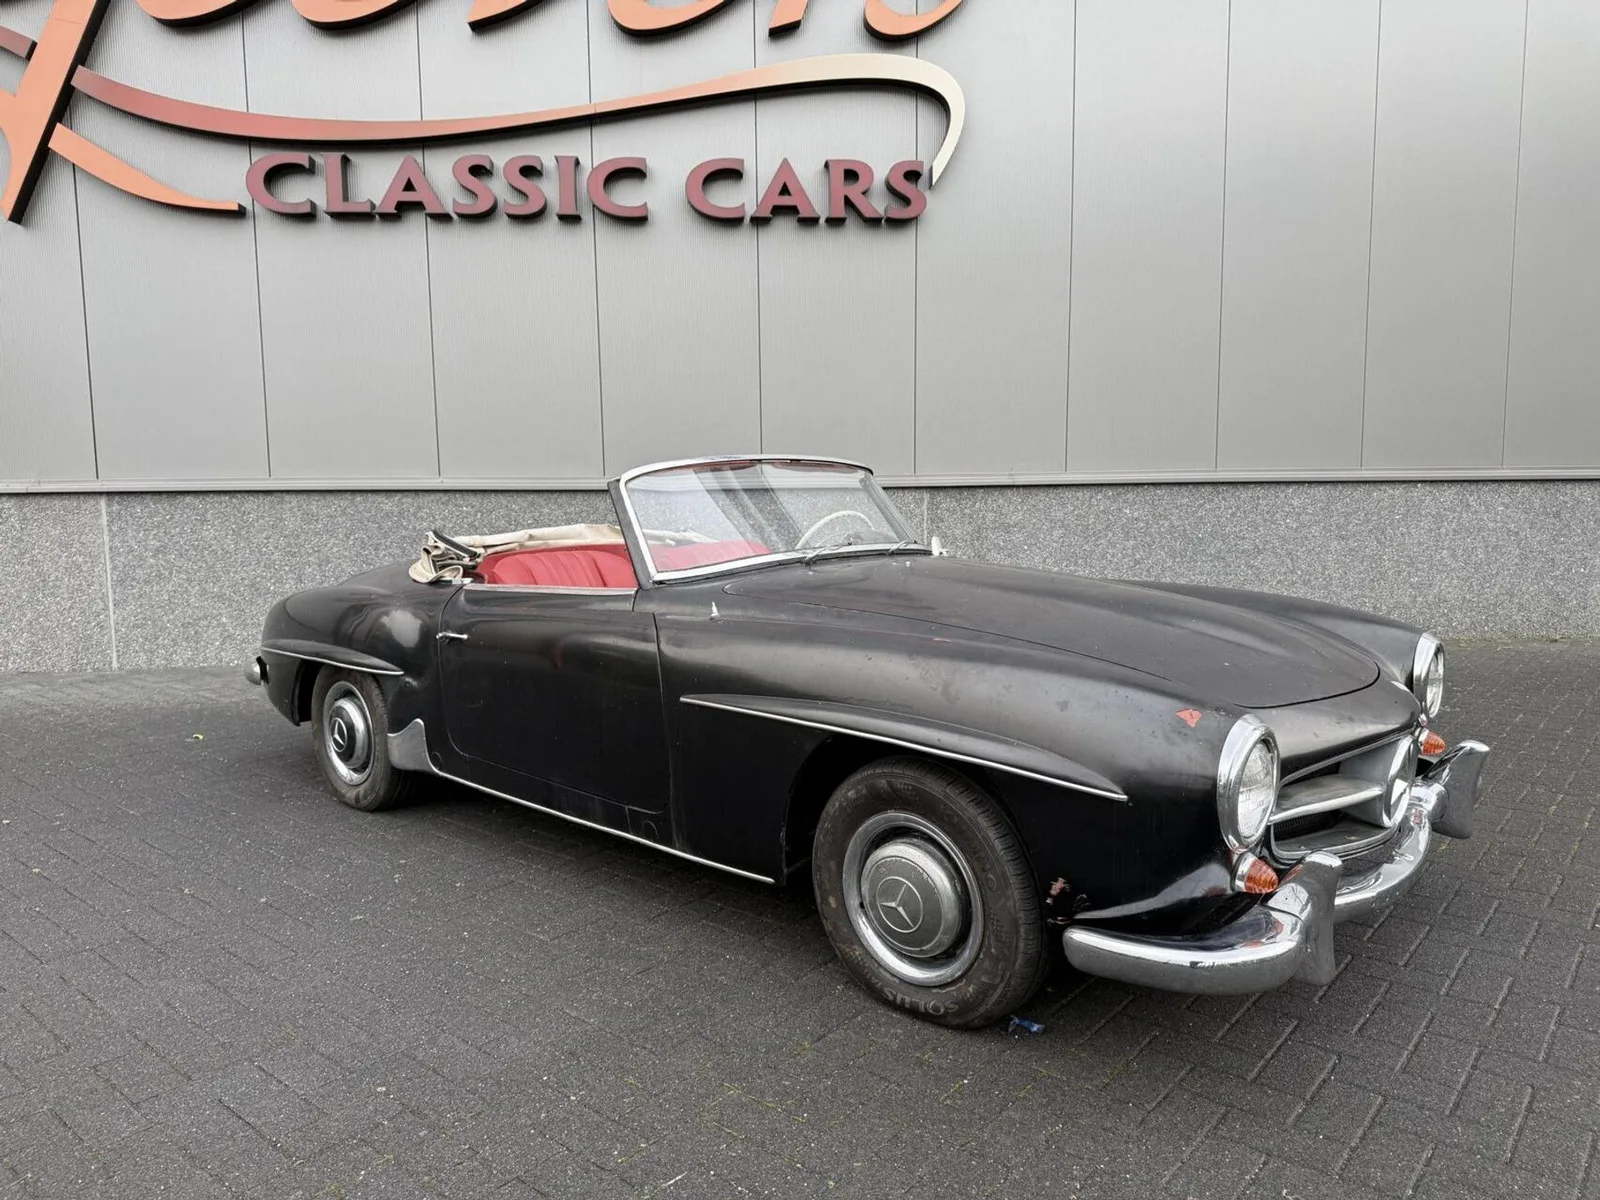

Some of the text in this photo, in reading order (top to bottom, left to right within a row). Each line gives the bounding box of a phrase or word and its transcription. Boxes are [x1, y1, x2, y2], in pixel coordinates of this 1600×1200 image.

[245, 152, 928, 221] CLASSIC CARS
[881, 987, 960, 1015] SOLUS
